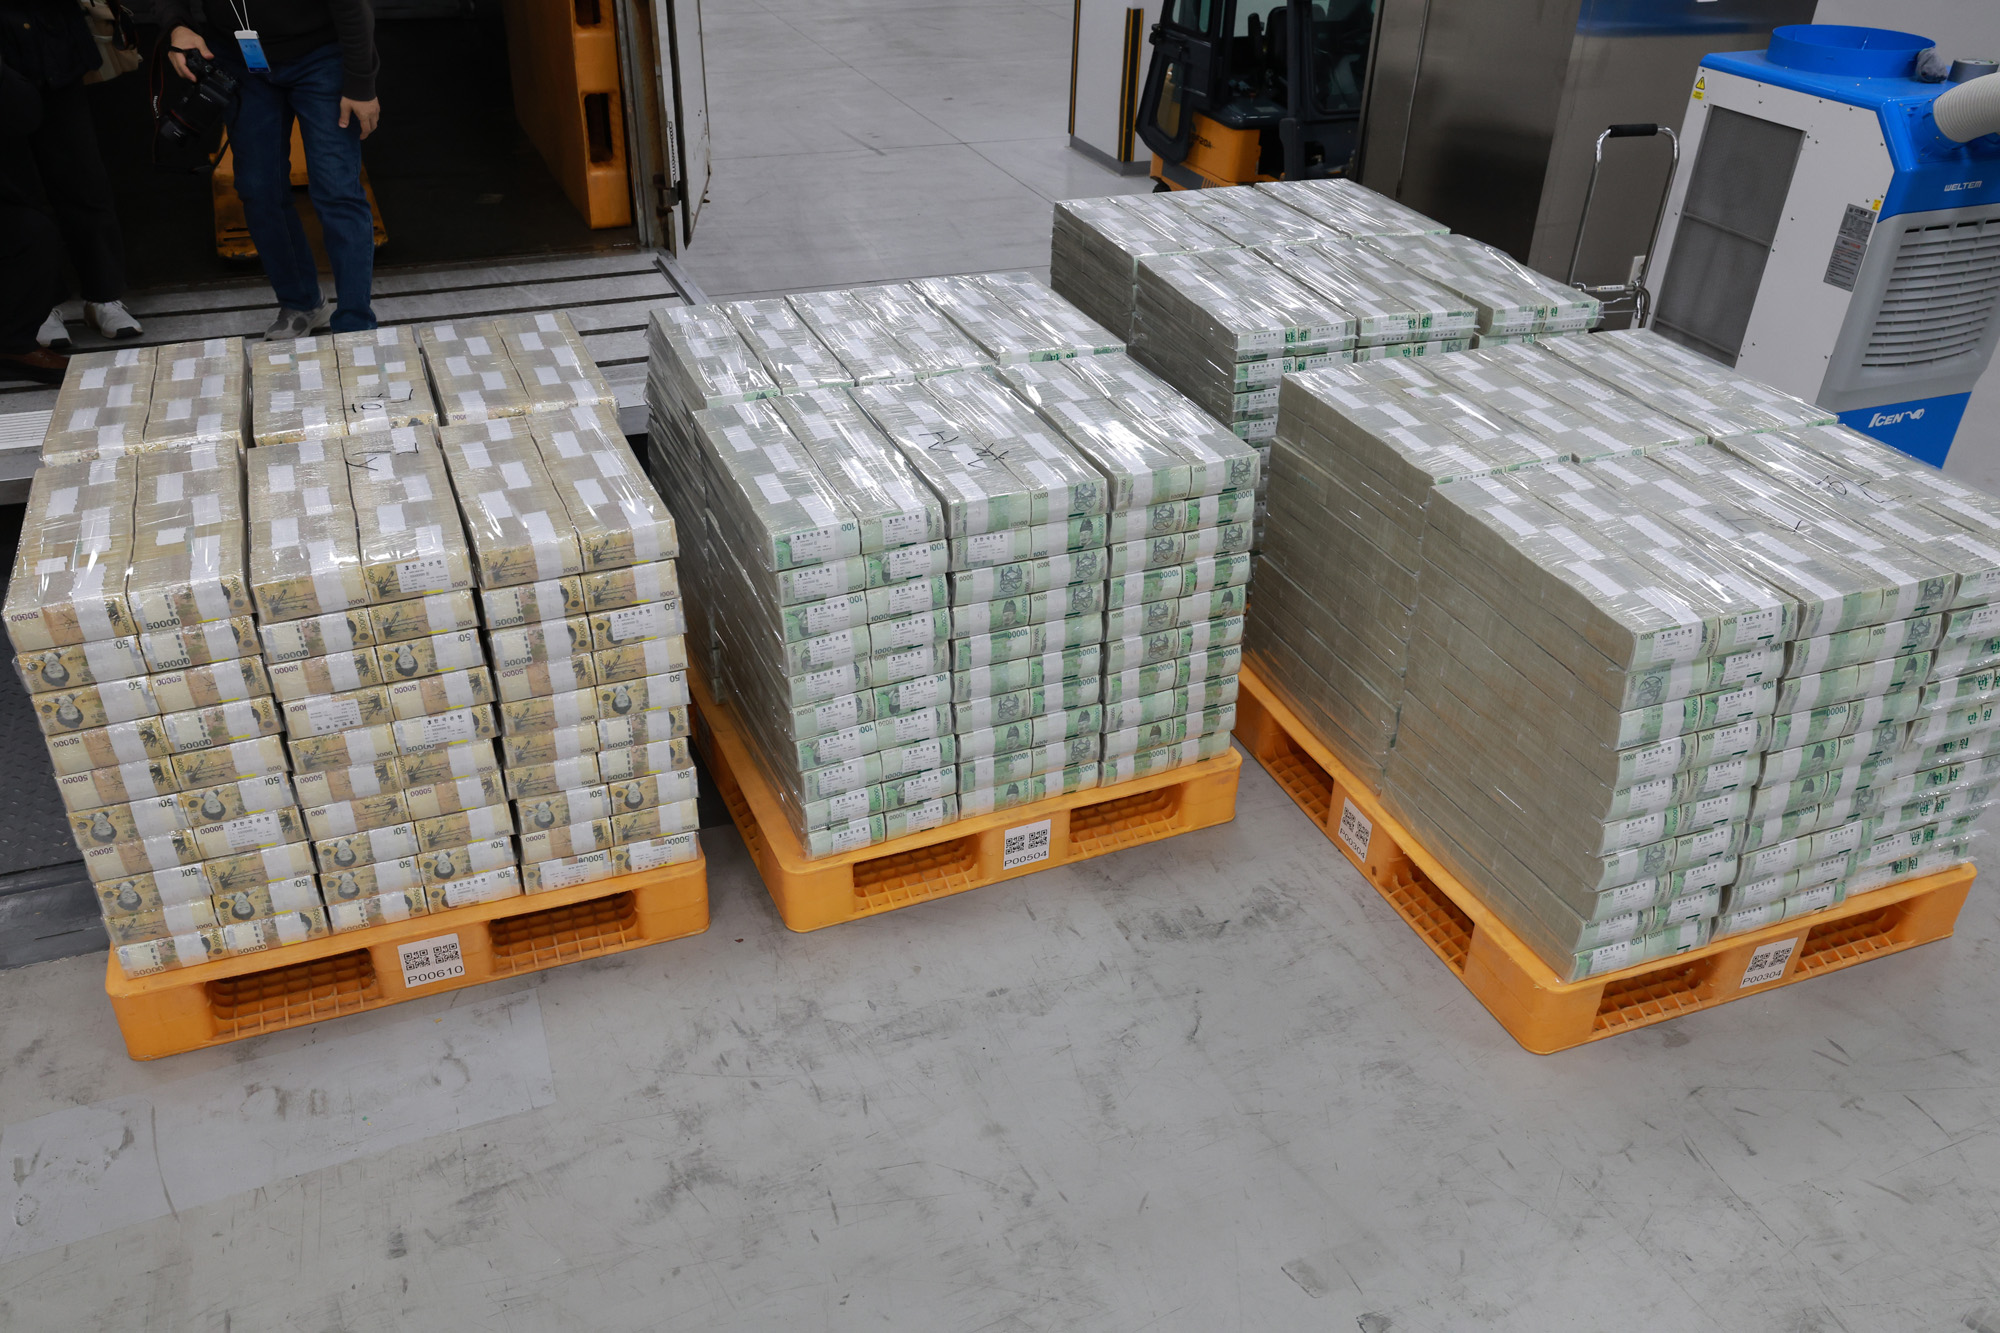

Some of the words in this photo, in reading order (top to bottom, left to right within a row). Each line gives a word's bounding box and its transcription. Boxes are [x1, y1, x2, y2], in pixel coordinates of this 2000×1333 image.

[146, 618, 180, 630] 50000
[277, 650, 308, 660] 50000
[157, 658, 190, 670] 50000
[180, 738, 212, 750] 50000
[1004, 850, 1047, 866] P00504
[408, 966, 463, 984] P00610
[1742, 970, 1782, 985] P00304
